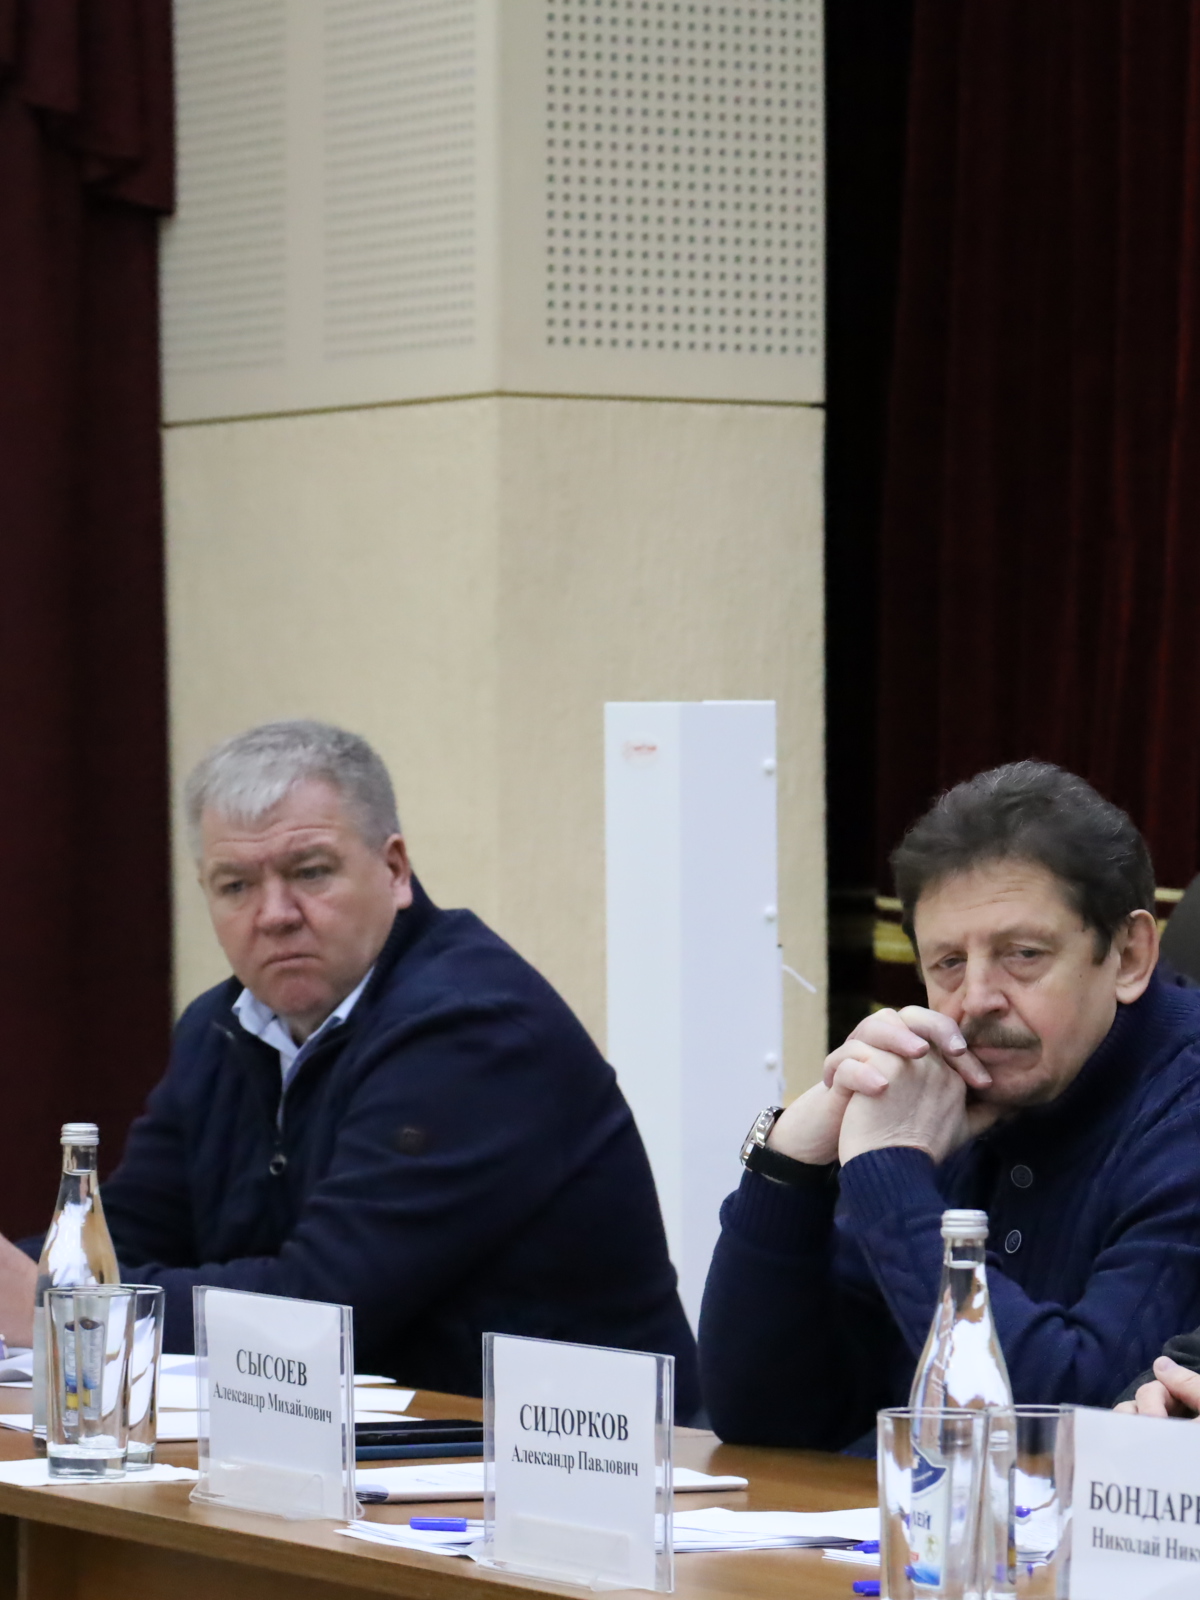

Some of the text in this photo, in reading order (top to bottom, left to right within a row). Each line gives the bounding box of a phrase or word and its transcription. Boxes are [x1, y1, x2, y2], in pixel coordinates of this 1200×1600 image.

[236, 1349, 307, 1386] СЫСОЕВ
[213, 1382, 332, 1424] Александр Михайлович
[520, 1404, 629, 1441] СИДОРКОВ
[511, 1443, 639, 1477] Александр Павлович
[1092, 1526, 1160, 1557] Николай
